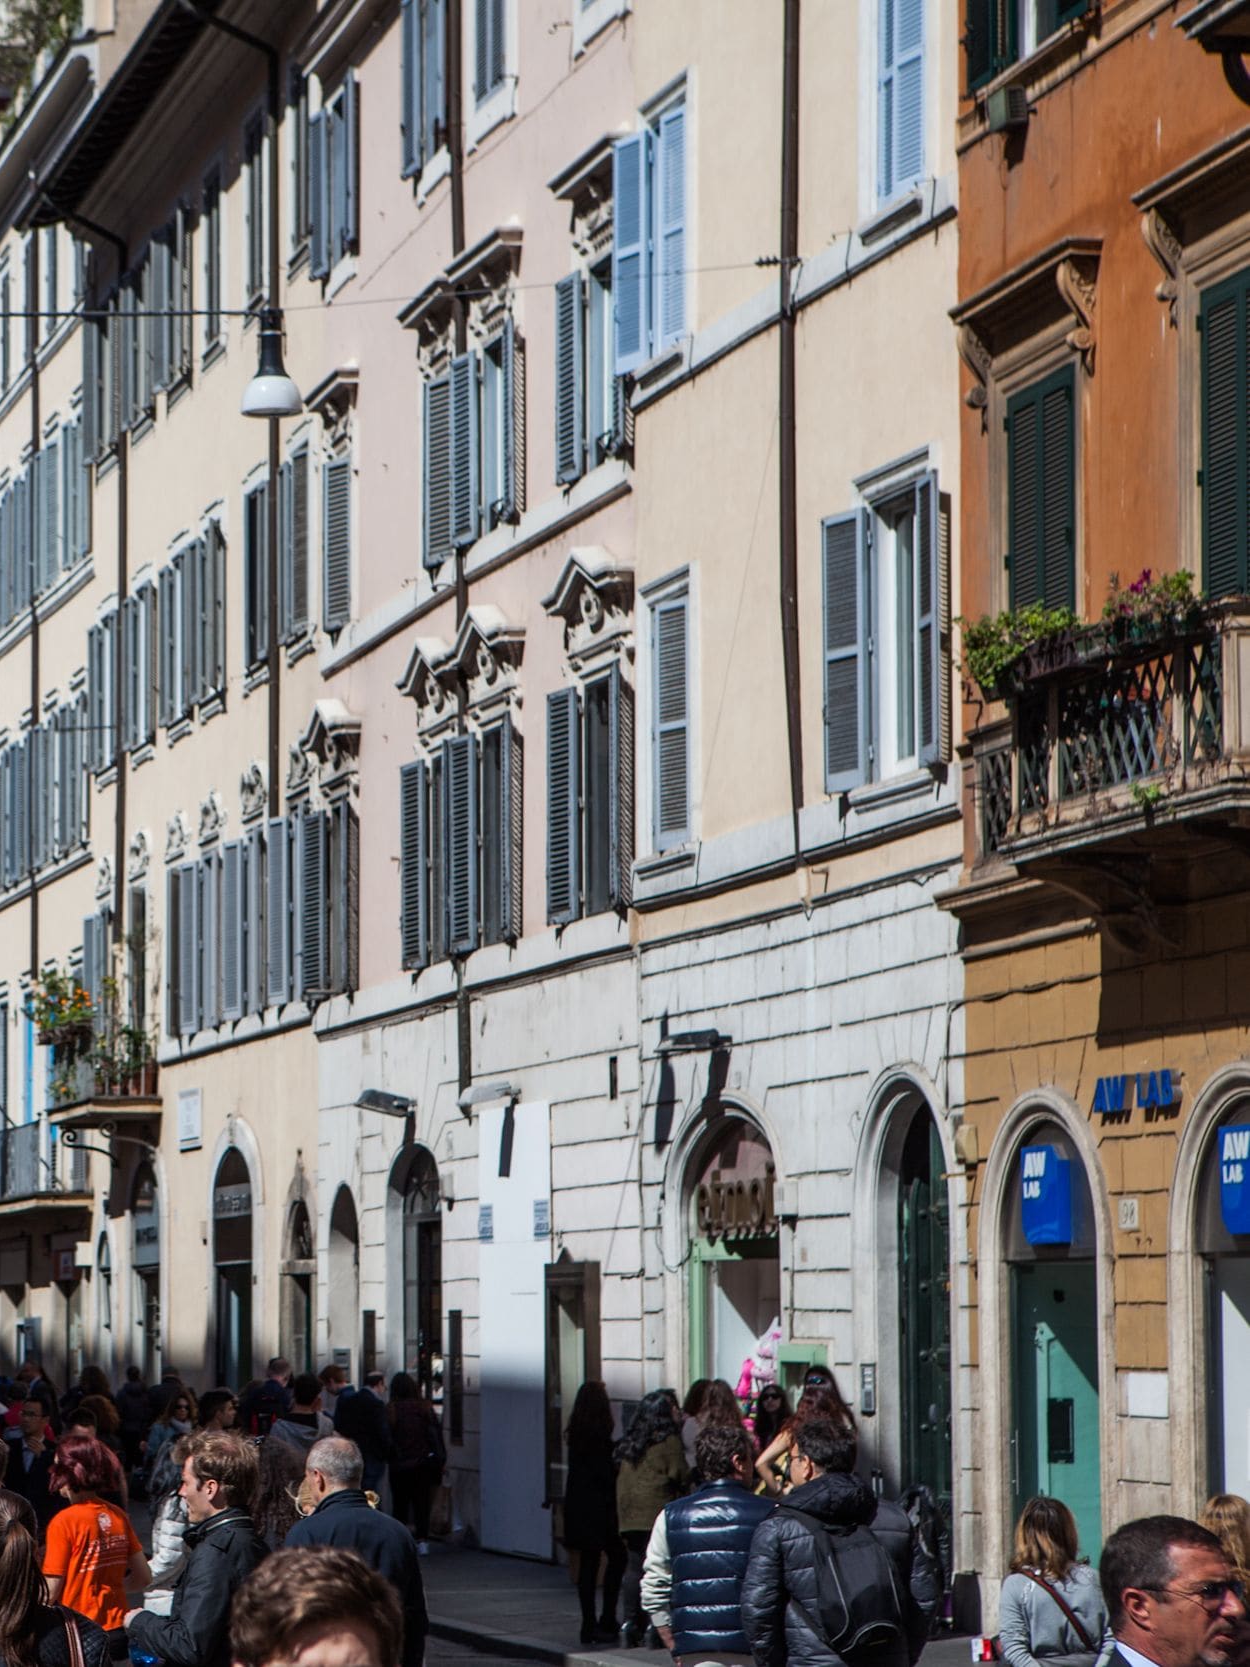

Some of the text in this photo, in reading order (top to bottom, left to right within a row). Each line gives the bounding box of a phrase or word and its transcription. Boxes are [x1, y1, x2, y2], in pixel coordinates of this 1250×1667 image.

[1093, 1069, 1173, 1113] AW LAB
[1223, 1132, 1250, 1161] AW
[1023, 1151, 1047, 1179] AW
[1222, 1164, 1244, 1184] LAB
[1023, 1181, 1041, 1199] LAB
